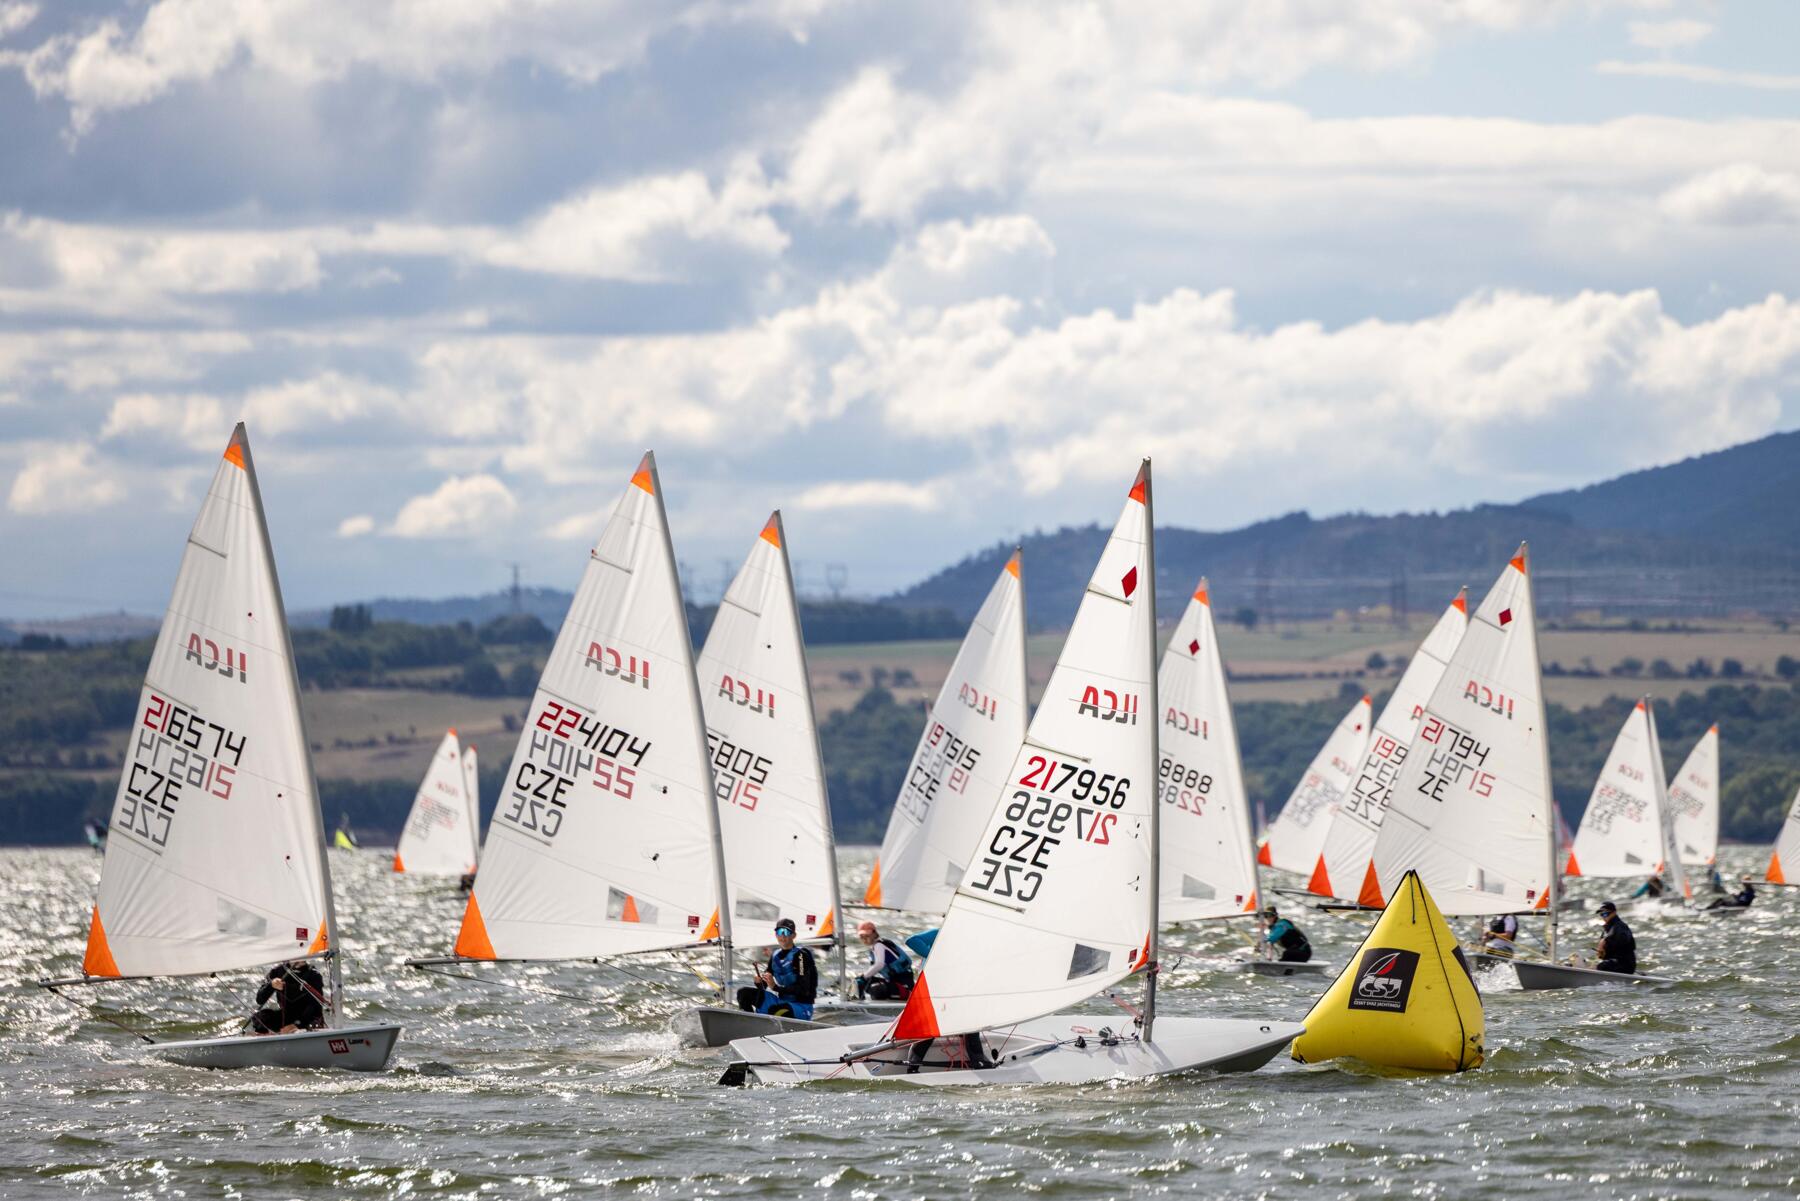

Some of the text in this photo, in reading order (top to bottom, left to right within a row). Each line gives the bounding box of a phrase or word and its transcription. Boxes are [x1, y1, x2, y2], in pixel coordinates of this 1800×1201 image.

[143, 695, 247, 766] 216574
[536, 701, 652, 767] 224104
[127, 762, 182, 814] CZE
[515, 762, 574, 809] CZE
[910, 765, 940, 801] CZE
[1019, 755, 1131, 809] 217956
[1418, 770, 1449, 802] ZE
[989, 825, 1061, 870] CZE
